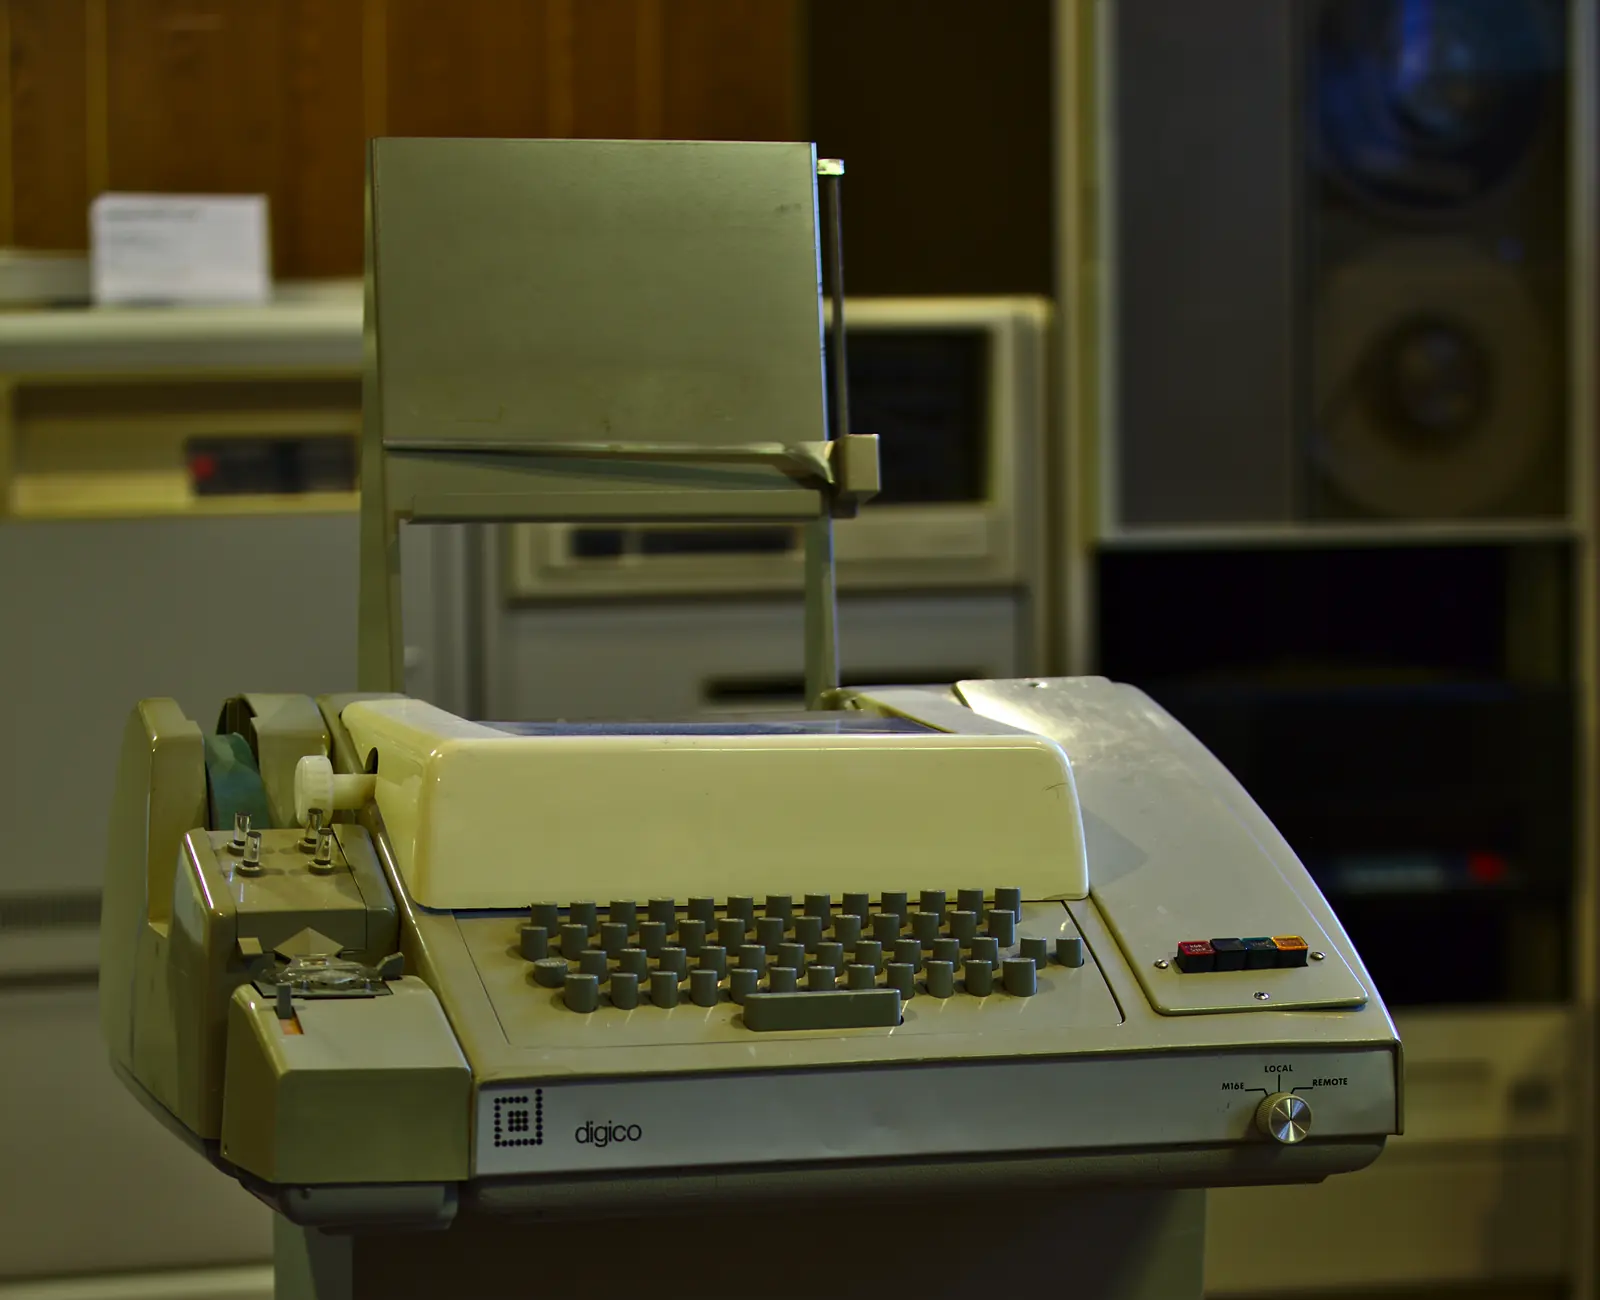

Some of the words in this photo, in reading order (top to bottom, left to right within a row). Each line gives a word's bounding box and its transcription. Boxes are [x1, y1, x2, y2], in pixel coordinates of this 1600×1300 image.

[1264, 1064, 1293, 1073] LOCAL
[1312, 1078, 1348, 1087] REMOTE
[575, 1120, 642, 1147] digico
